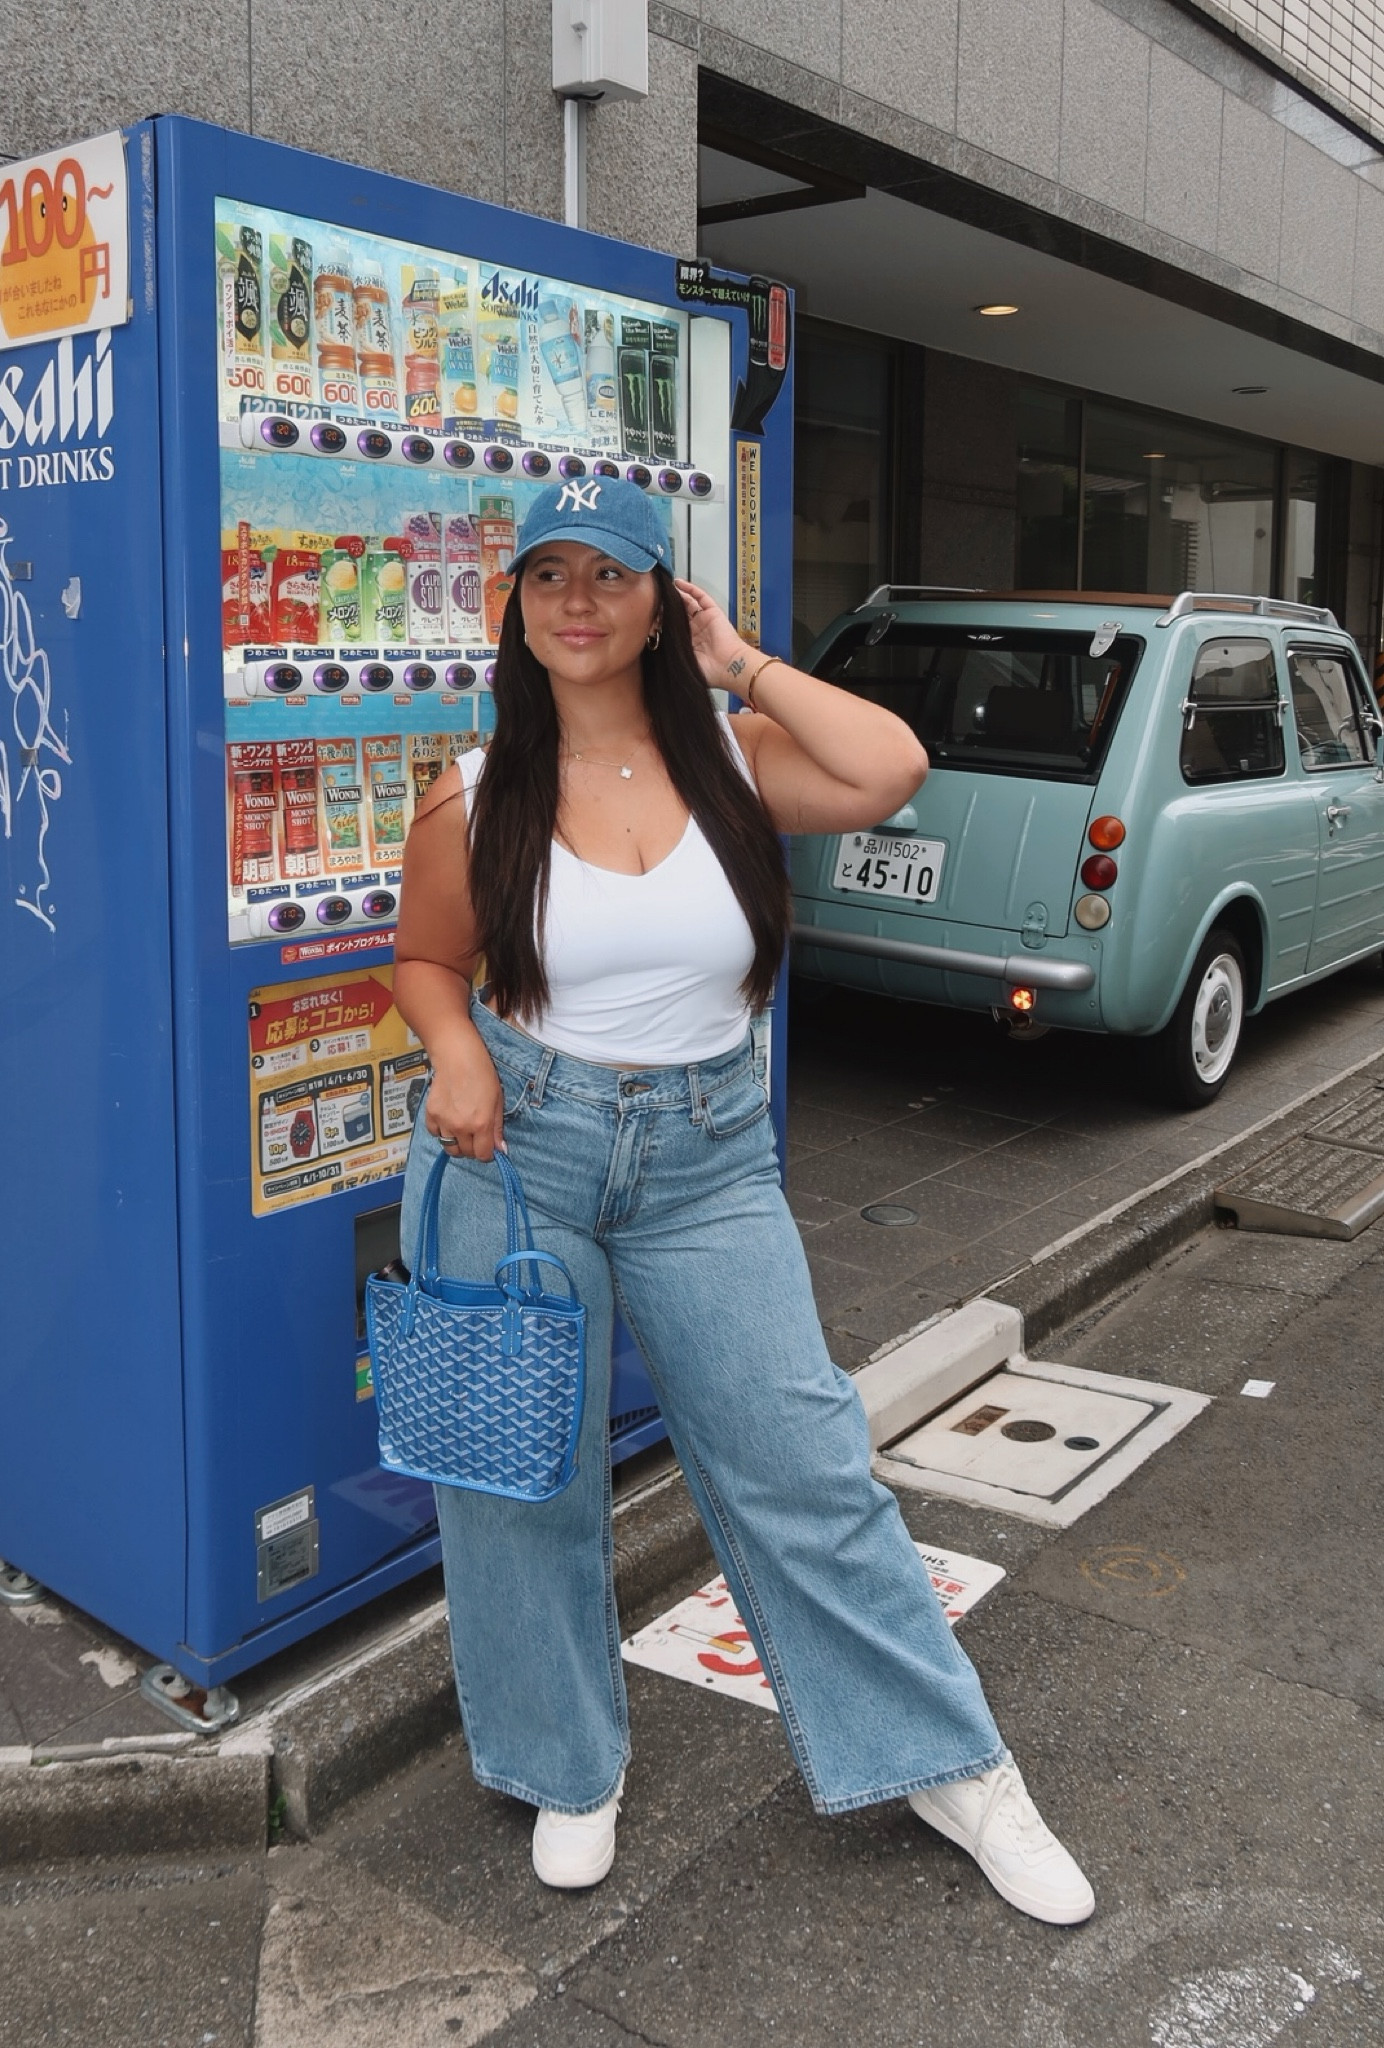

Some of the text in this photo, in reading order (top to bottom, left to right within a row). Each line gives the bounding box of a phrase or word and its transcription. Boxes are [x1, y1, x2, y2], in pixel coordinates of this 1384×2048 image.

[80, 243, 111, 303] 円
[0, 276, 62, 302] が合いましたね
[481, 270, 540, 312] Asahi
[678, 283, 751, 303] モンスターで超えていけ
[18, 293, 77, 320] これもなにかの
[334, 298, 351, 343] 麦茶
[373, 308, 390, 352] 麦茶
[528, 323, 545, 425] 自然が大切に育てた水
[243, 397, 279, 413] 120
[290, 403, 323, 421] 120
[410, 397, 437, 417] 600
[18, 446, 115, 487] DRINKS
[749, 447, 757, 632] WELCOME TO JAPAN
[327, 788, 361, 801] WONDA
[375, 784, 406, 797] WONDA
[244, 821, 266, 831] SHOT
[291, 817, 311, 827] SHOT
[841, 858, 934, 896] と 45-10
[250, 1004, 258, 1018] 1
[292, 990, 343, 1013] お忘れなく!
[265, 1001, 375, 1045] 応募はココから!
[255, 1057, 263, 1068] 2
